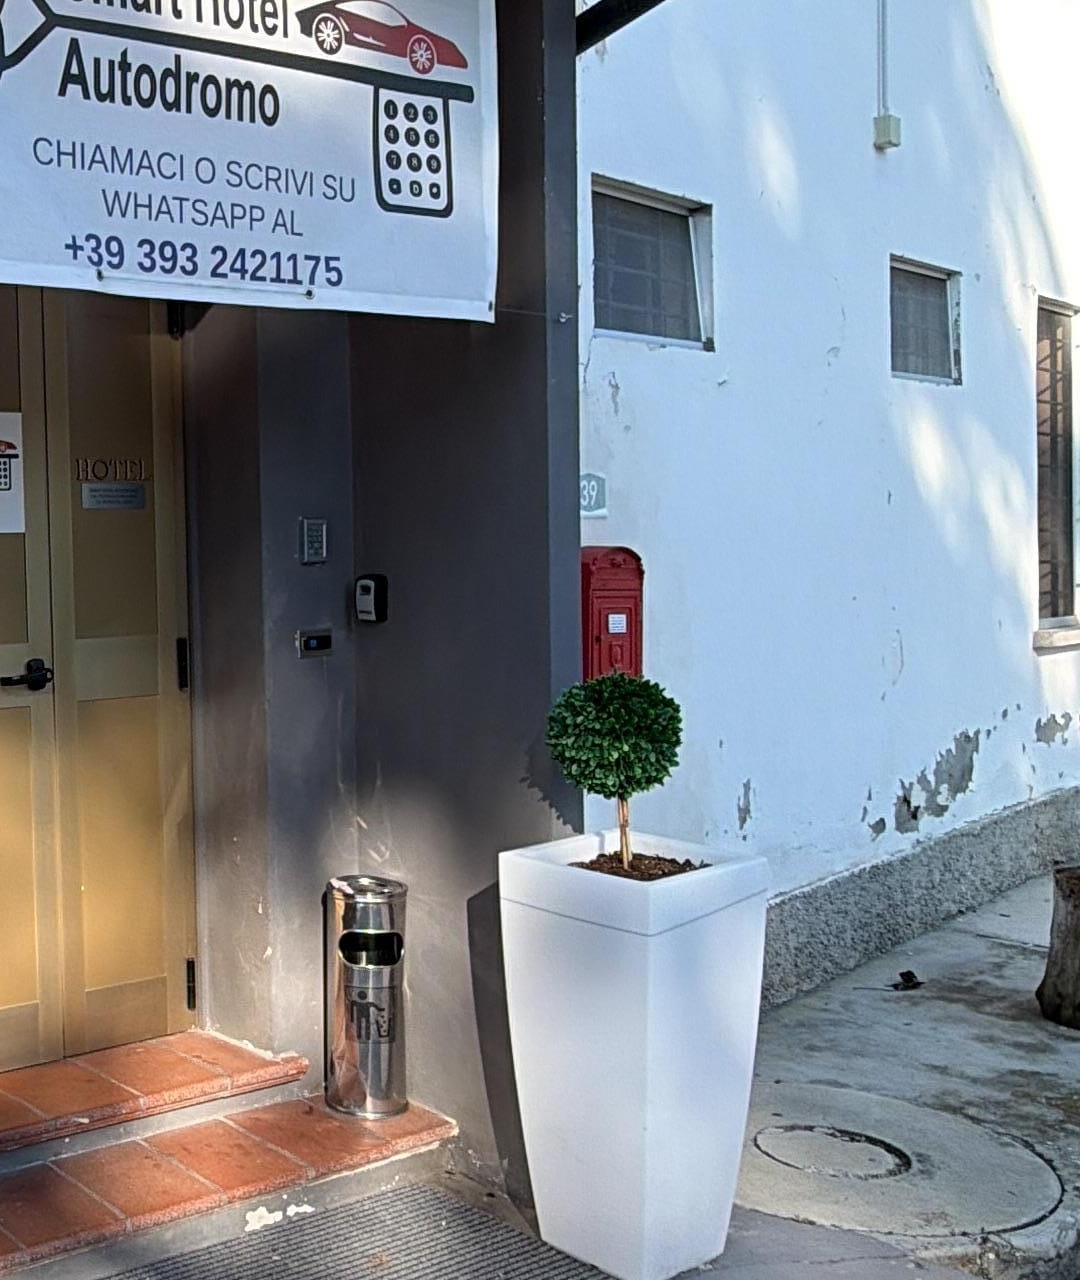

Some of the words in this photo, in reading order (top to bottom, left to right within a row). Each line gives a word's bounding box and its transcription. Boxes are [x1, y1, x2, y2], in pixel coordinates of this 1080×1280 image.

[57, 36, 281, 128] Autodromo
[32, 136, 185, 182] CHIAMACI
[194, 156, 217, 185] O
[225, 159, 315, 198] SCRIVI
[321, 173, 356, 203] SU
[101, 188, 266, 232] WHATSAPP
[271, 207, 304, 237] AL
[64, 232, 126, 271] +39
[136, 238, 200, 277] 393
[209, 244, 344, 288] 2421175
[75, 457, 152, 481] HOTEL
[580, 479, 598, 506] 39
